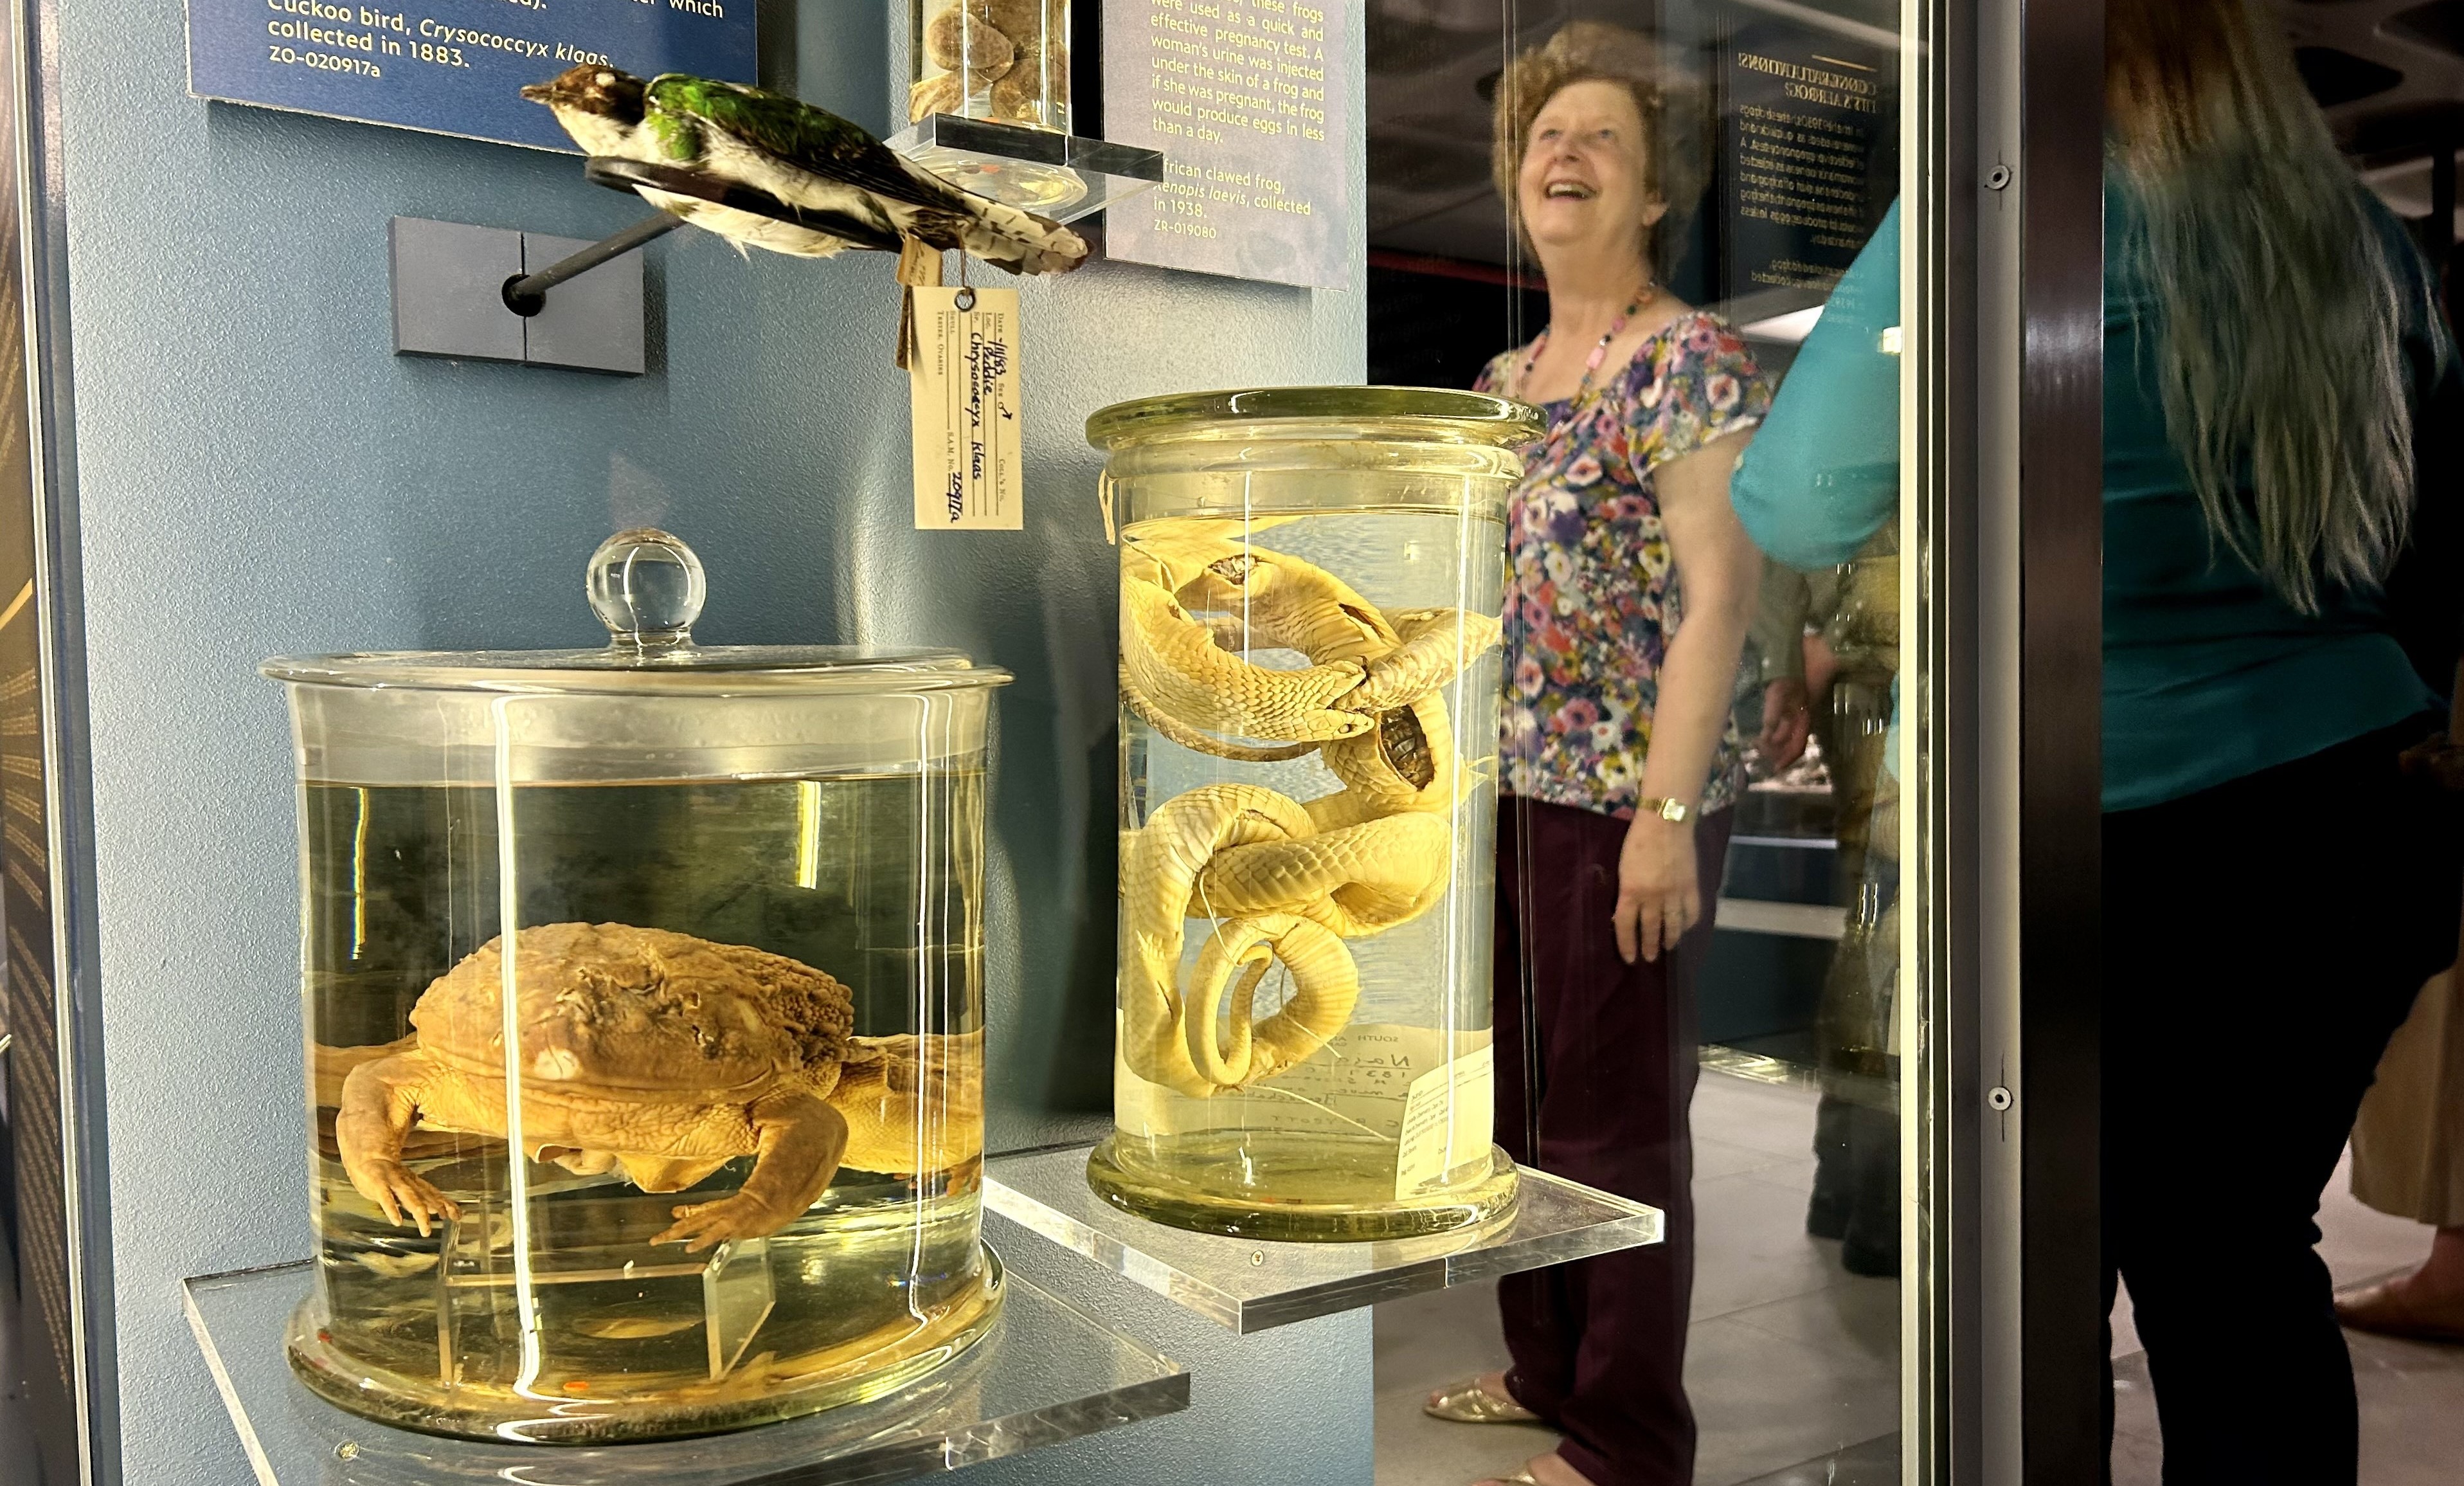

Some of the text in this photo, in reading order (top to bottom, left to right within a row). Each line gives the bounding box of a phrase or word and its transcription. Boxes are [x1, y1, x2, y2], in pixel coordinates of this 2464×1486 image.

[1190, 2, 1220, 19] used
[1227, 10, 1241, 24] as
[1247, 15, 1255, 27] a
[1261, 17, 1295, 35] quick
[1300, 26, 1324, 42] and
[1292, 2, 1324, 24] frogs
[267, 0, 615, 68] Cuckoo bird, Crysococcyx klaas.
[267, 20, 471, 68] collected in 1883.
[1150, 14, 1324, 62] effective pregnancy test. A
[269, 45, 381, 78] ZO-020917a
[1151, 35, 1324, 82] woman's urine was injected
[1151, 56, 1324, 102] under the skin of a frog and
[1151, 74, 1324, 124] if she was pregnant, the frog
[1151, 98, 1325, 141] would produce eggs in less
[1152, 117, 1224, 144] than a day.
[1163, 158, 1286, 195] frican clawed frog,
[1153, 196, 1208, 219] in 1938.
[1209, 185, 1250, 208] laevis,
[1254, 195, 1311, 215] collected
[1154, 219, 1218, 239] ZR-019080
